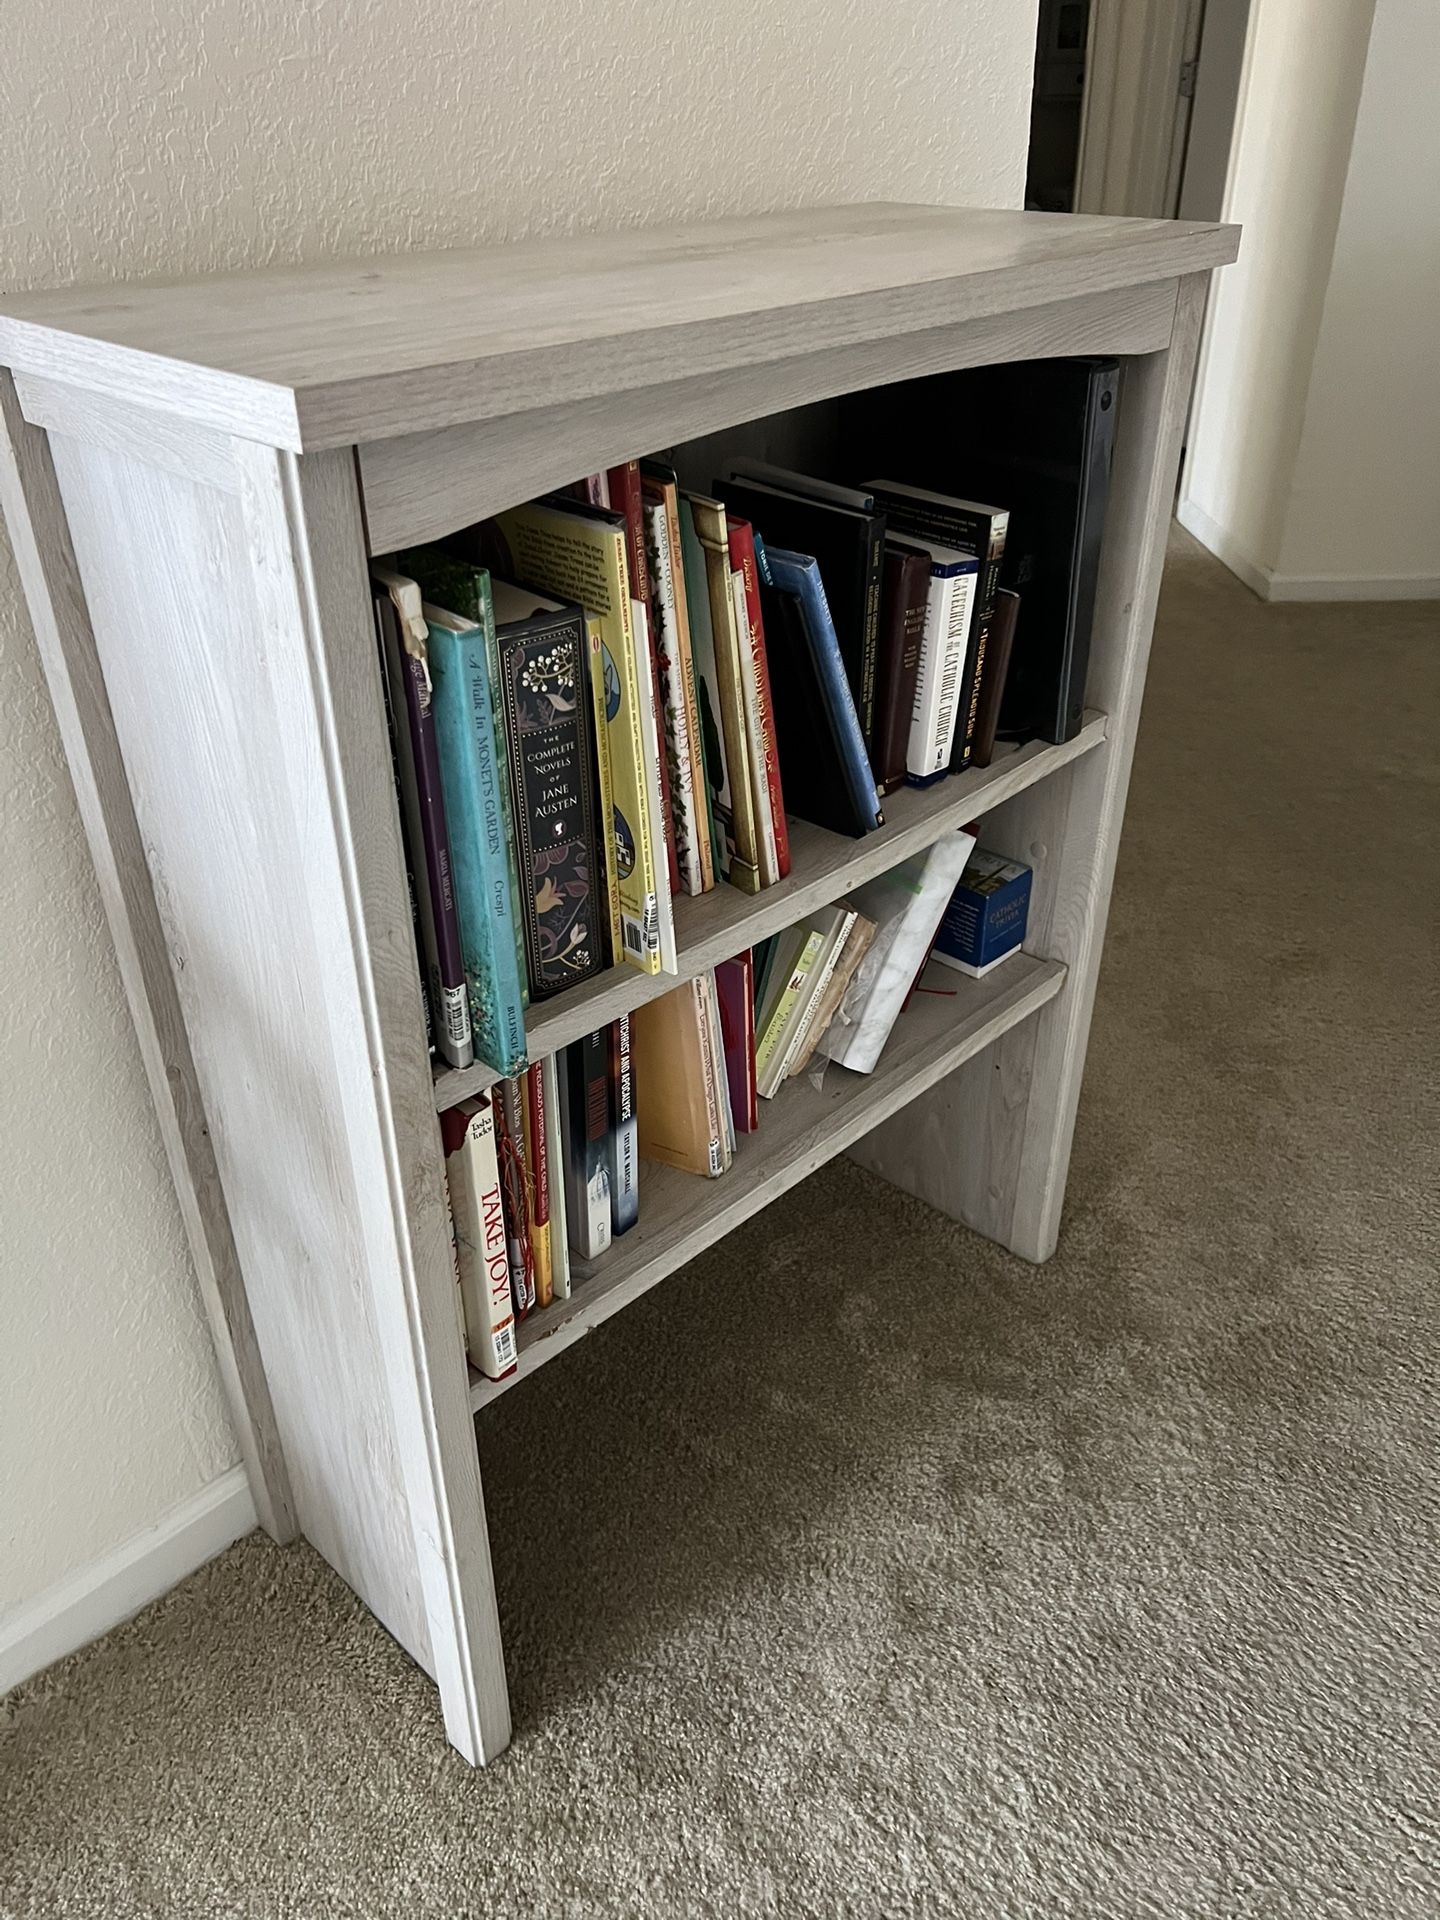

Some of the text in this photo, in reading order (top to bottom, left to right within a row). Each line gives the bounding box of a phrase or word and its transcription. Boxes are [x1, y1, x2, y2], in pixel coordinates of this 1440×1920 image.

[658, 514, 674, 610] GODDEN COONEY
[619, 587, 629, 632] ORNAMENTS
[947, 576, 968, 640] CATECHISM
[468, 654, 481, 669] A
[974, 632, 988, 676] THOUSAND
[471, 675, 485, 709] Walk
[940, 652, 958, 704] CATHOLIC
[968, 676, 981, 719] SPLENDID
[474, 715, 486, 729] In
[684, 657, 702, 768] ADVENT CALENDAR
[934, 703, 951, 748] CHURCH
[675, 707, 689, 750] HOLLY
[965, 718, 974, 739] SUNS
[527, 742, 575, 762] COMPLETE
[534, 756, 572, 774] NOVELS
[598, 751, 606, 768] AND
[680, 755, 690, 767] &
[757, 755, 765, 771] THE
[542, 784, 569, 802] JANE
[600, 769, 611, 819] MONASTERIES
[682, 770, 693, 794] IVY
[759, 773, 768, 793] MAGI
[536, 796, 578, 818] AUSTEN
[483, 799, 500, 854] GARDEN
[492, 880, 506, 917] Crespi
[990, 896, 1026, 924] CATHOLIC
[996, 910, 1019, 928] TRIVIA
[506, 1006, 518, 1048] BULFINCH
[619, 1055, 629, 1072] AND
[535, 1070, 543, 1107] RELIGIOUS
[620, 1073, 630, 1121] APOCALYPSE
[704, 1081, 714, 1101] Dragon
[472, 1118, 492, 1132] Tasha
[512, 1107, 524, 1128] Blos
[537, 1109, 545, 1145] POTENTIAL
[471, 1126, 492, 1140] Tudor
[539, 1147, 545, 1155] OF
[479, 1182, 505, 1250] TAKE
[483, 1250, 511, 1306] JOY!
